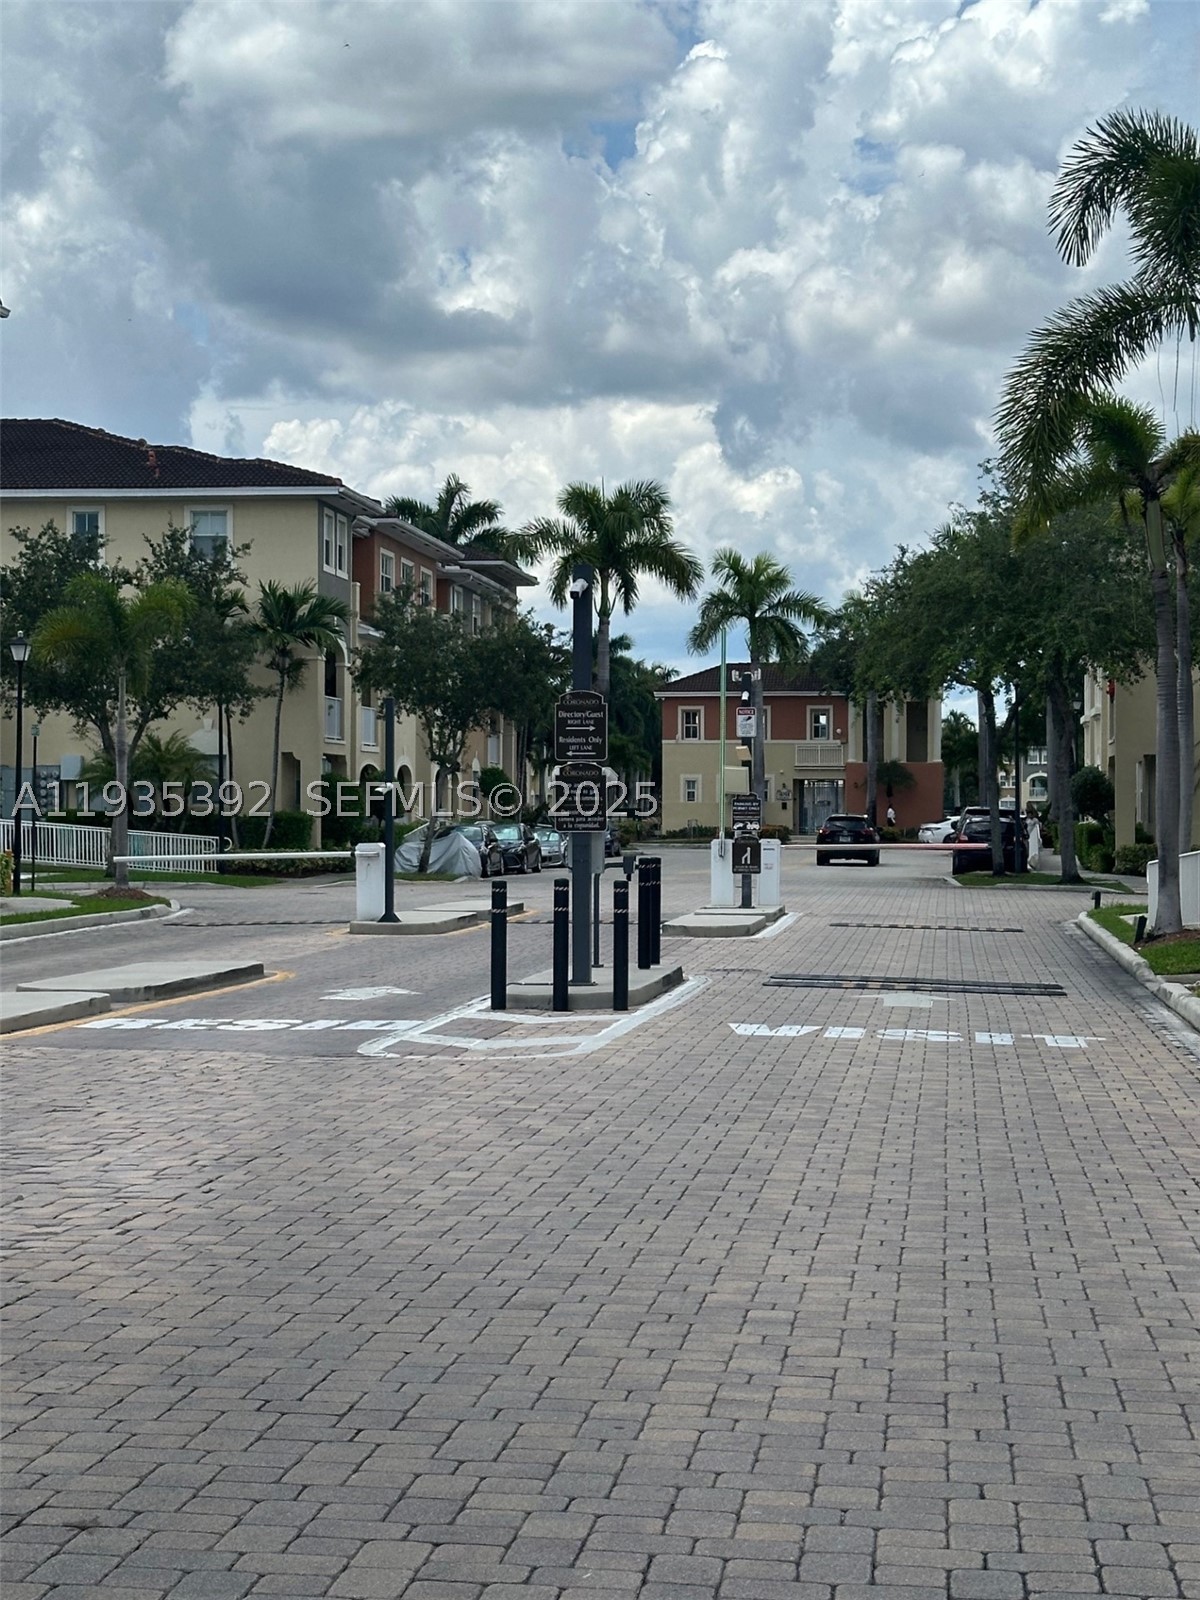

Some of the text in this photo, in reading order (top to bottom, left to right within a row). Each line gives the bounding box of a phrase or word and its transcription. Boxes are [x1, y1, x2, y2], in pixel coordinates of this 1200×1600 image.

[558, 710, 604, 719] Directory/Guest
[588, 736, 603, 744] Only
[727, 1022, 1108, 1049] VISIT
